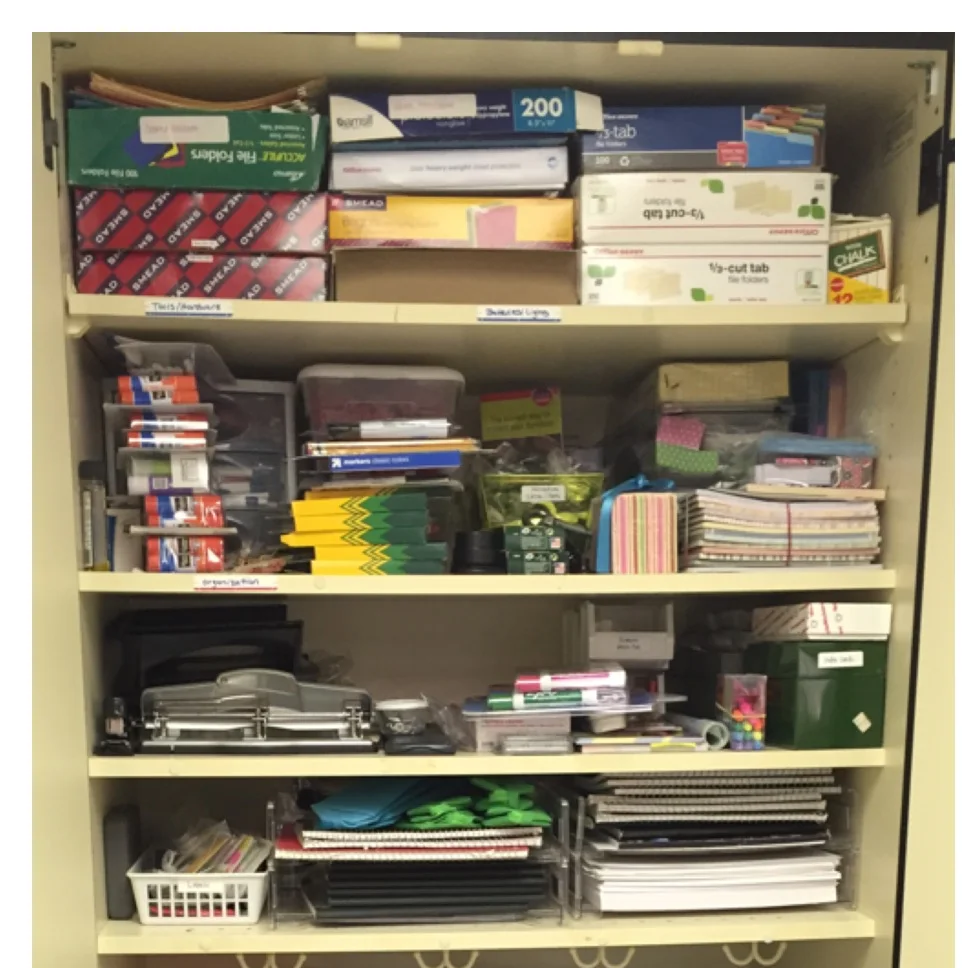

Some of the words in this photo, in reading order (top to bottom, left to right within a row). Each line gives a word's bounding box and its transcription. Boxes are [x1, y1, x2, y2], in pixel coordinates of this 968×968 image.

[521, 98, 563, 117] 200
[191, 150, 233, 163] Folders
[236, 151, 257, 164] File
[345, 199, 384, 207] SMEAD
[95, 207, 129, 244] SMEAD
[643, 209, 663, 221] tab
[167, 209, 201, 245] SMEAD
[240, 210, 273, 245] SMEAD
[833, 245, 878, 267] CHALK
[131, 256, 165, 292] SMEAD
[203, 257, 237, 294] SMEAD
[274, 260, 308, 296] SMEAD
[750, 262, 770, 274] tab
